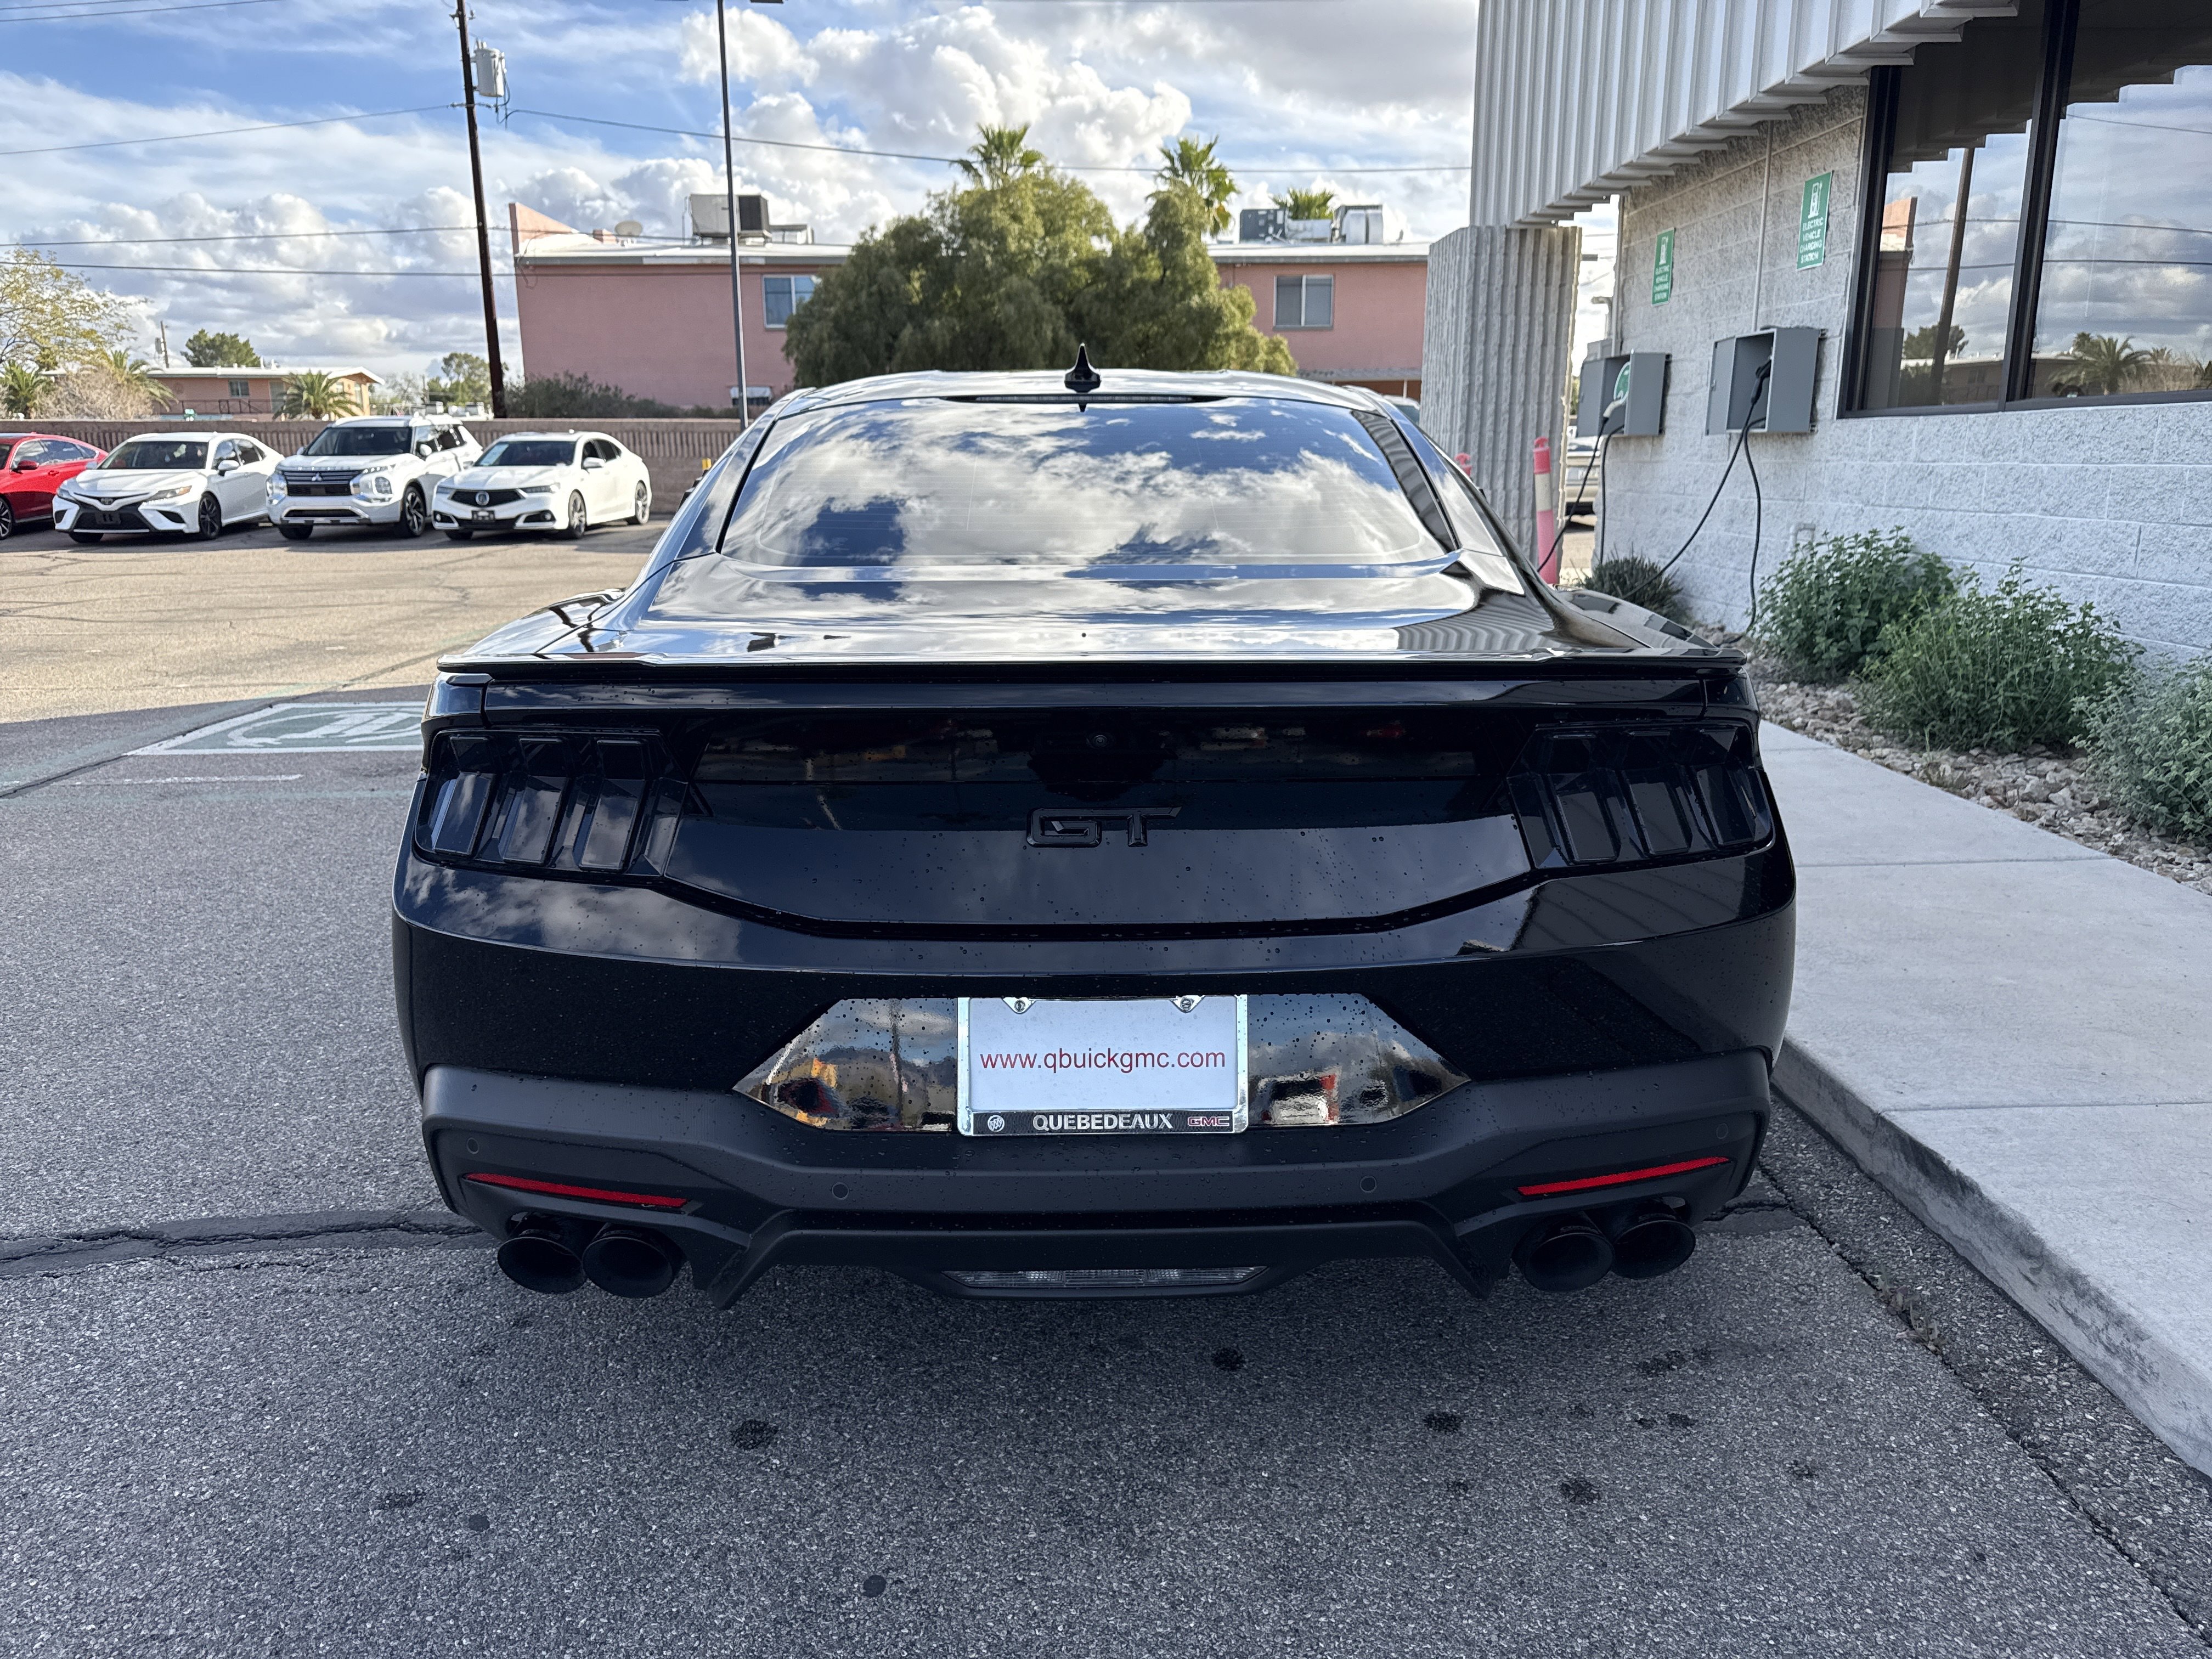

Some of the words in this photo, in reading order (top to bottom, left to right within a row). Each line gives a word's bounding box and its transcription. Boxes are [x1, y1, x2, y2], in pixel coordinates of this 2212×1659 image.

[1802, 217, 1824, 232] ELECTRIC
[1803, 228, 1821, 241] VEHICLE
[1799, 239, 1822, 253] CHARGING
[1801, 252, 1819, 264] STATION
[1026, 806, 1182, 848] GT
[980, 1048, 1225, 1074] www.qbuickgmc.com
[1032, 1113, 1173, 1131] QUEBEDEAUX
[1187, 1116, 1229, 1127] GMC
